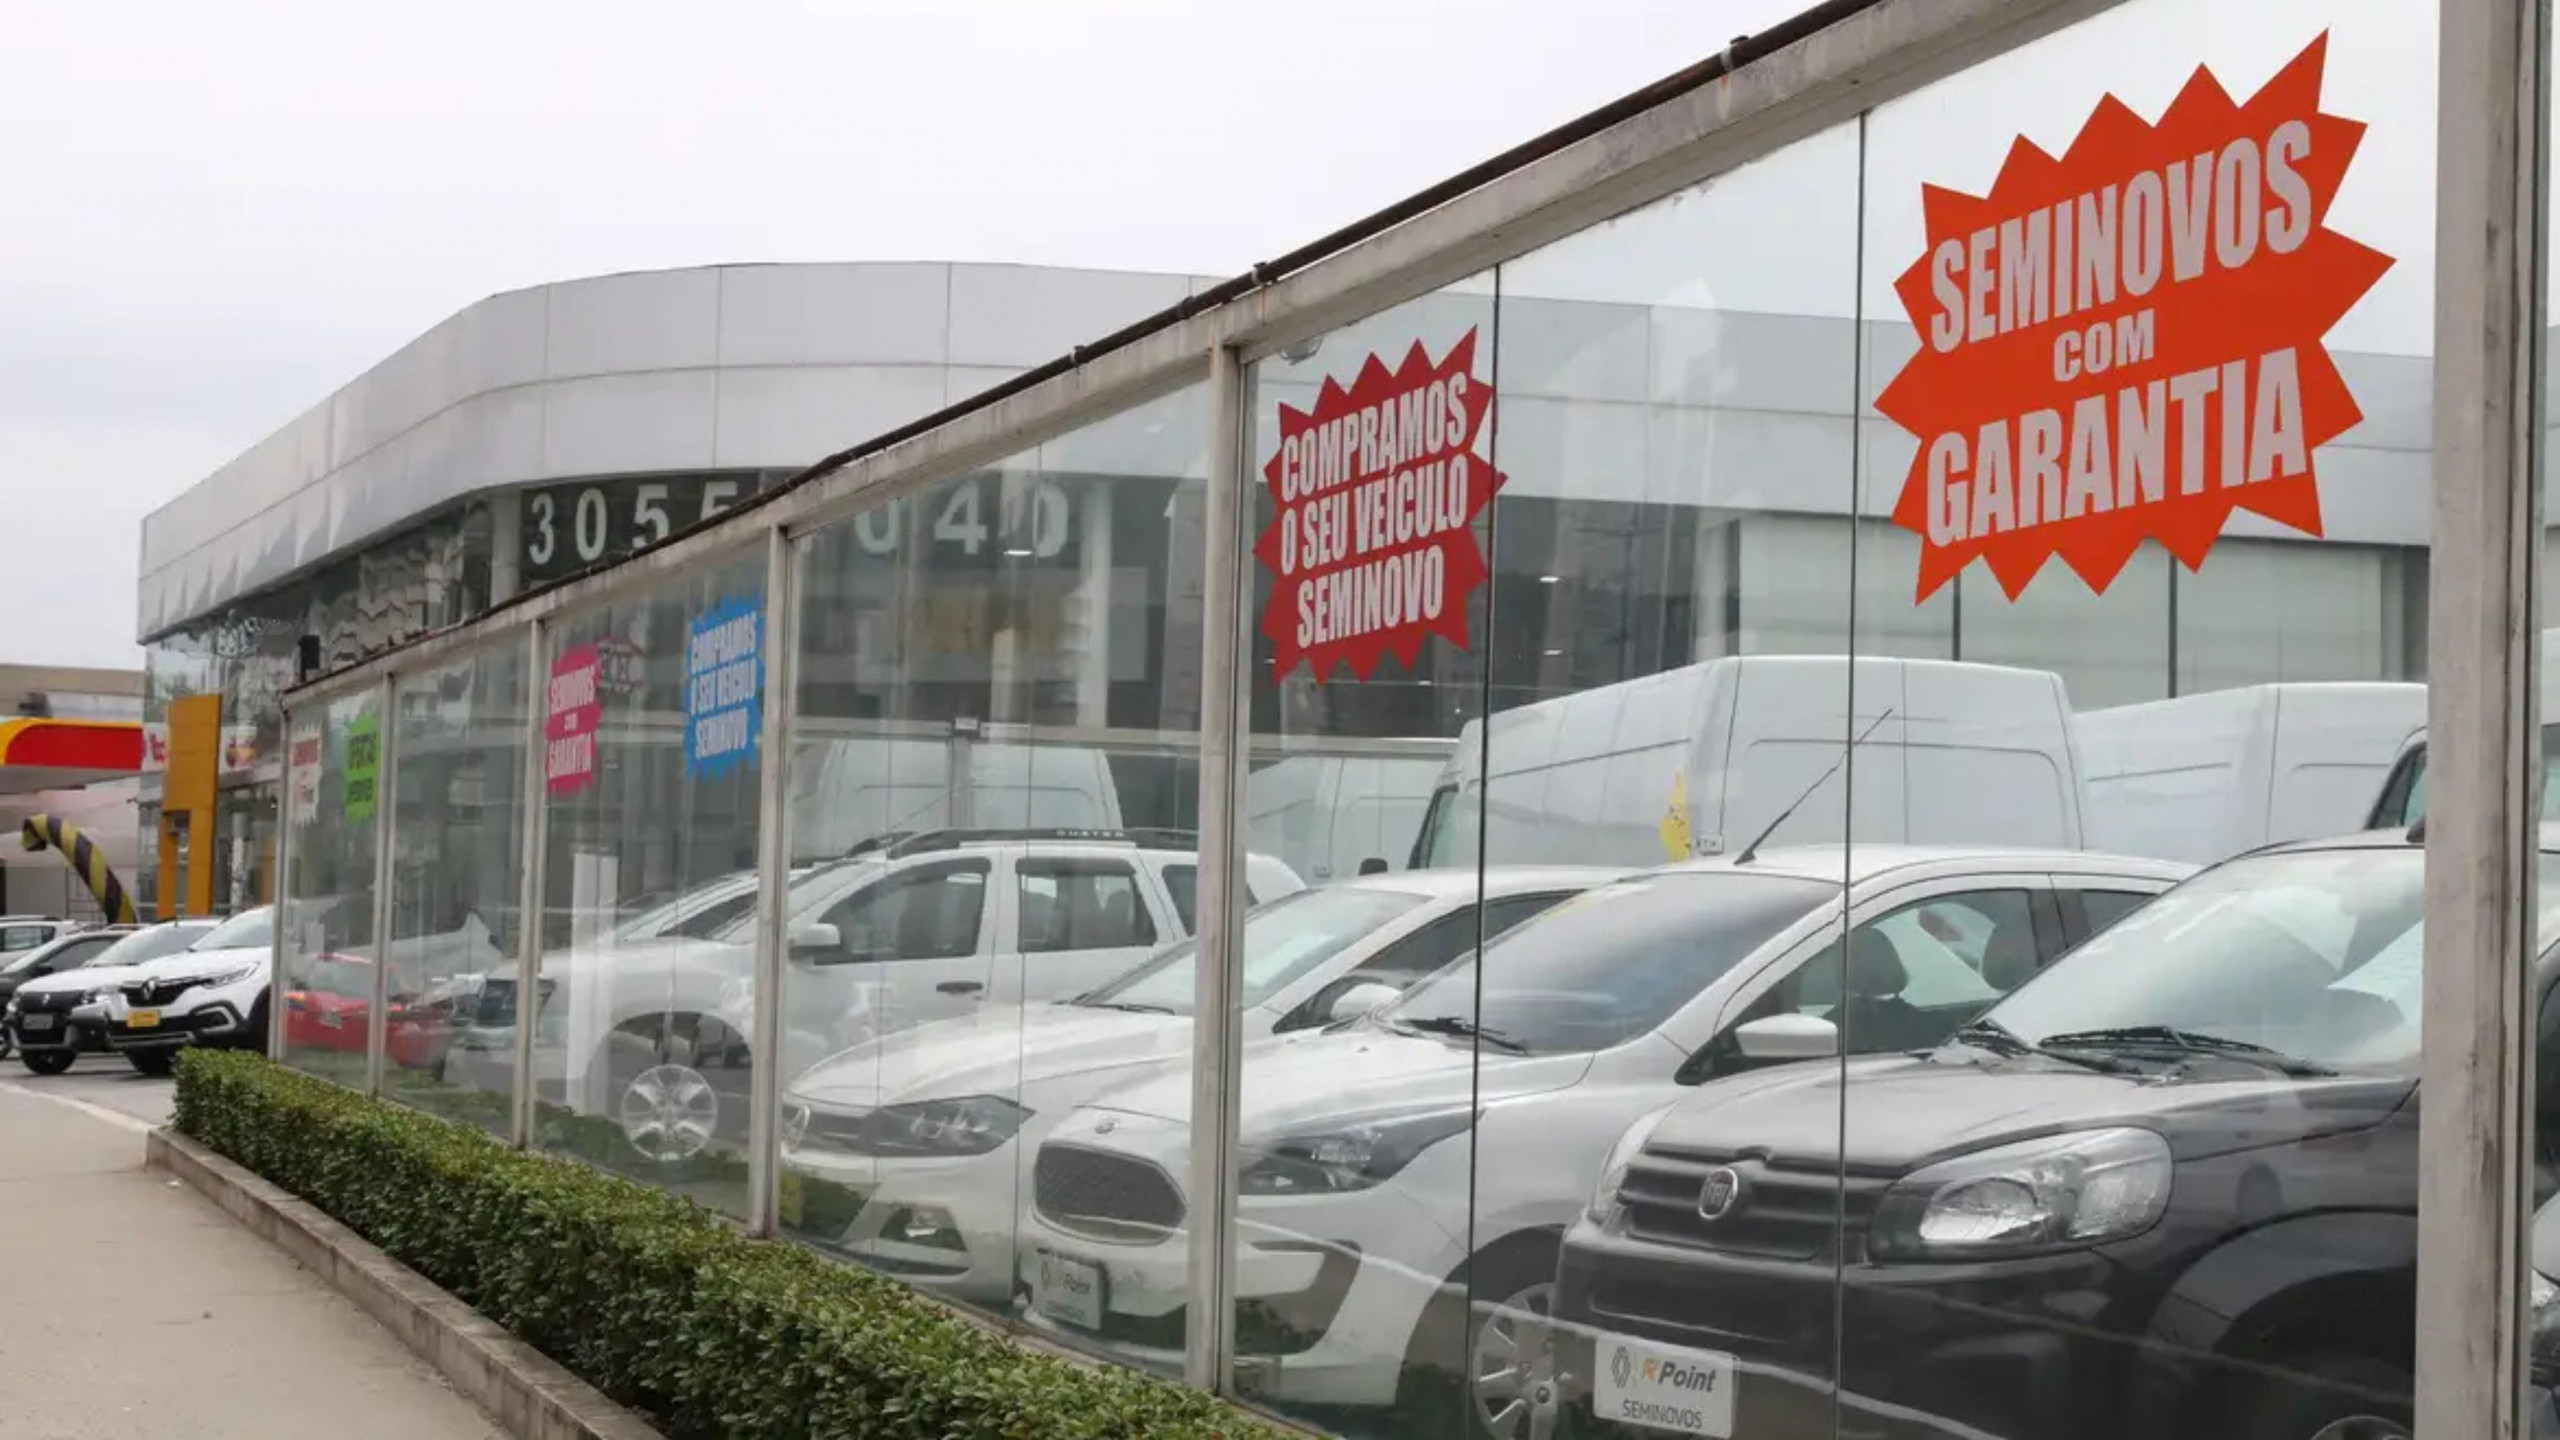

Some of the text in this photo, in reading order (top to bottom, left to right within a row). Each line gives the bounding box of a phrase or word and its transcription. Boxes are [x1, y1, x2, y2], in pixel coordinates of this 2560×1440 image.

[1930, 119, 2312, 354] SEMINOVOS
[2053, 308, 2155, 382] COM
[1281, 371, 1467, 503] COMPRAMOS
[1926, 346, 2307, 548] GARANTIA
[1281, 452, 1469, 576] O SEU VEÍCULO
[1297, 544, 1444, 649] SEMINOVO
[1622, 1398, 1703, 1430] SEMINOVOS
